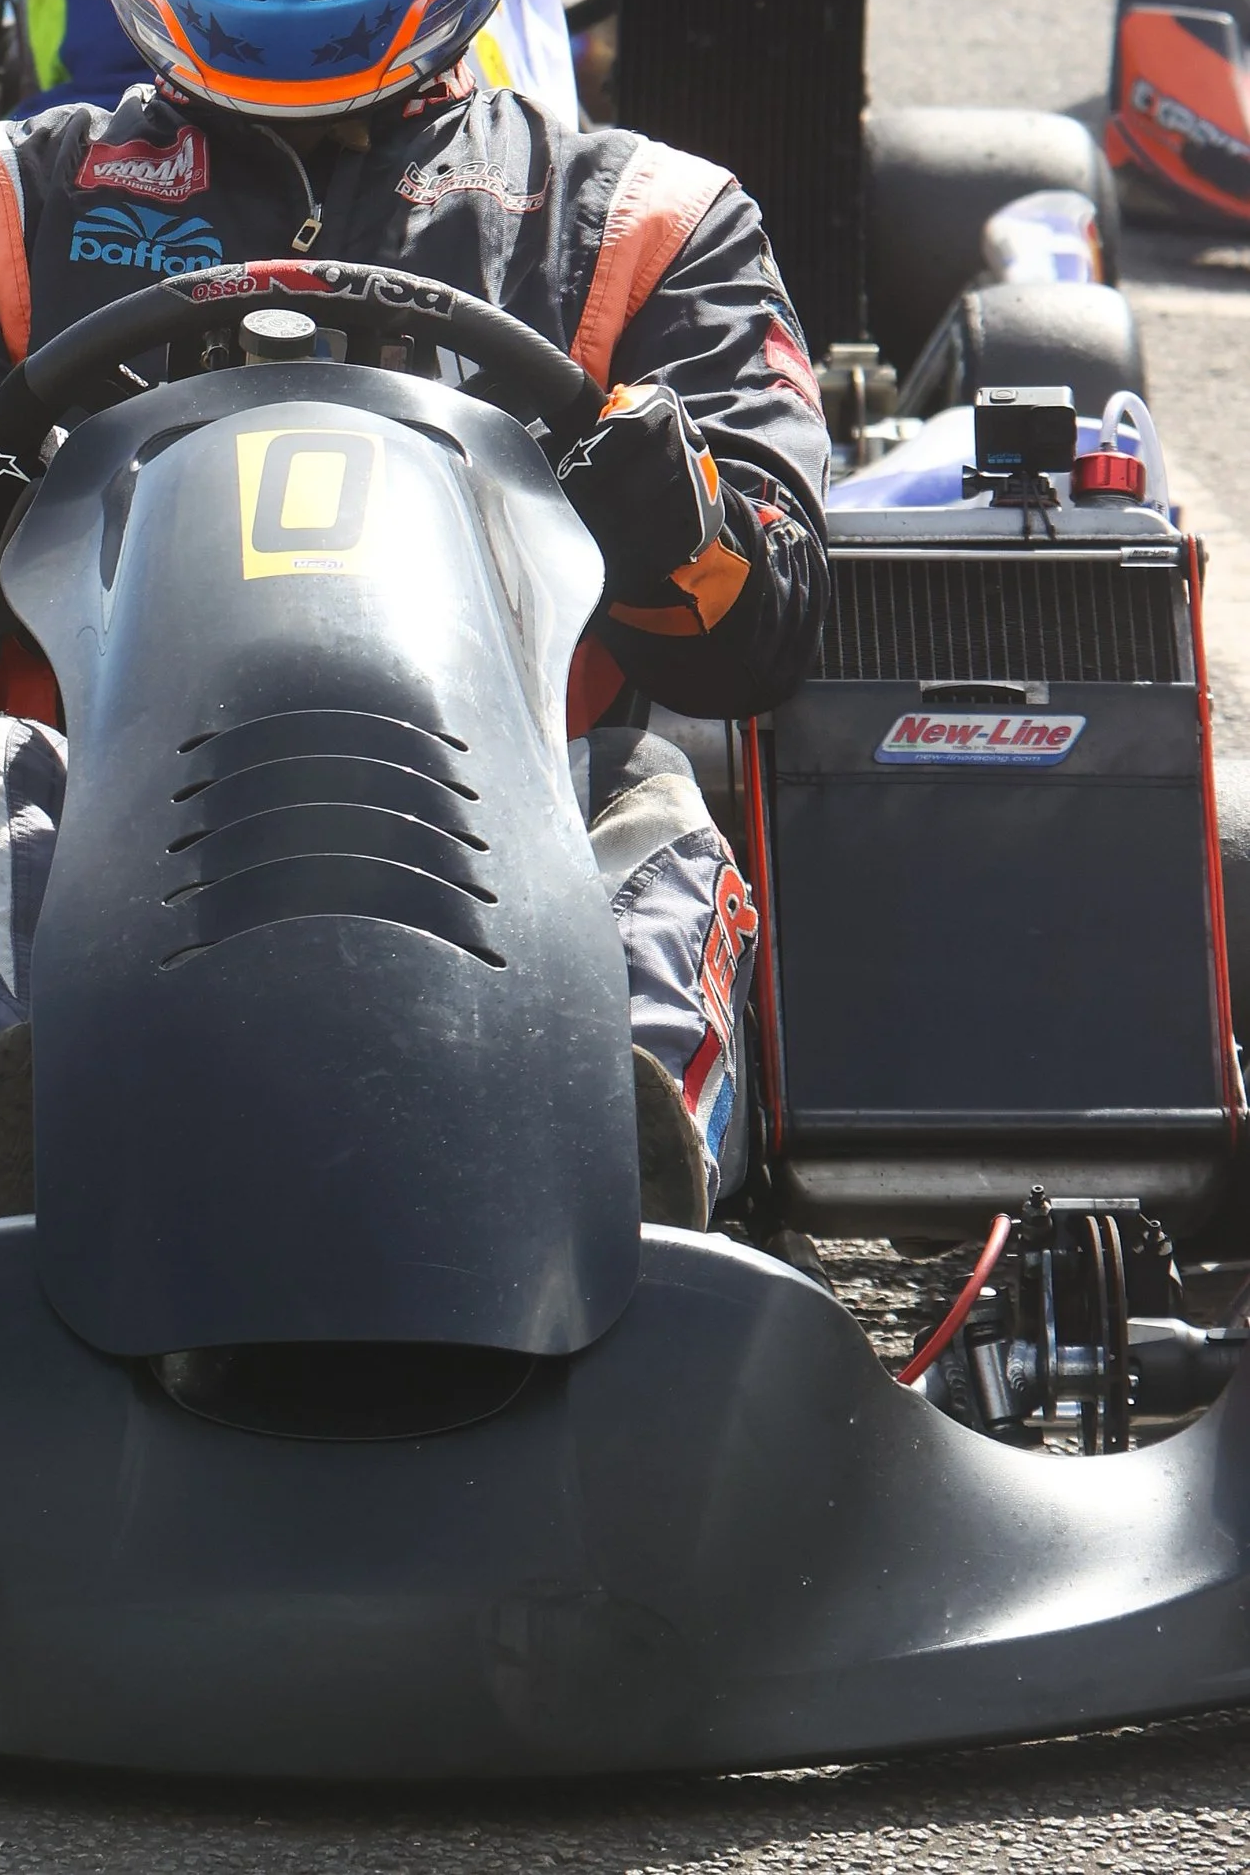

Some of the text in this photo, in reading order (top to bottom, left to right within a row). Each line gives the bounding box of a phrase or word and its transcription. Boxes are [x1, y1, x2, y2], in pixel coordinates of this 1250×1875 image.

[113, 177, 192, 198] LUBRICANTS
[251, 431, 376, 554] 0
[891, 716, 1071, 747] New-Line
